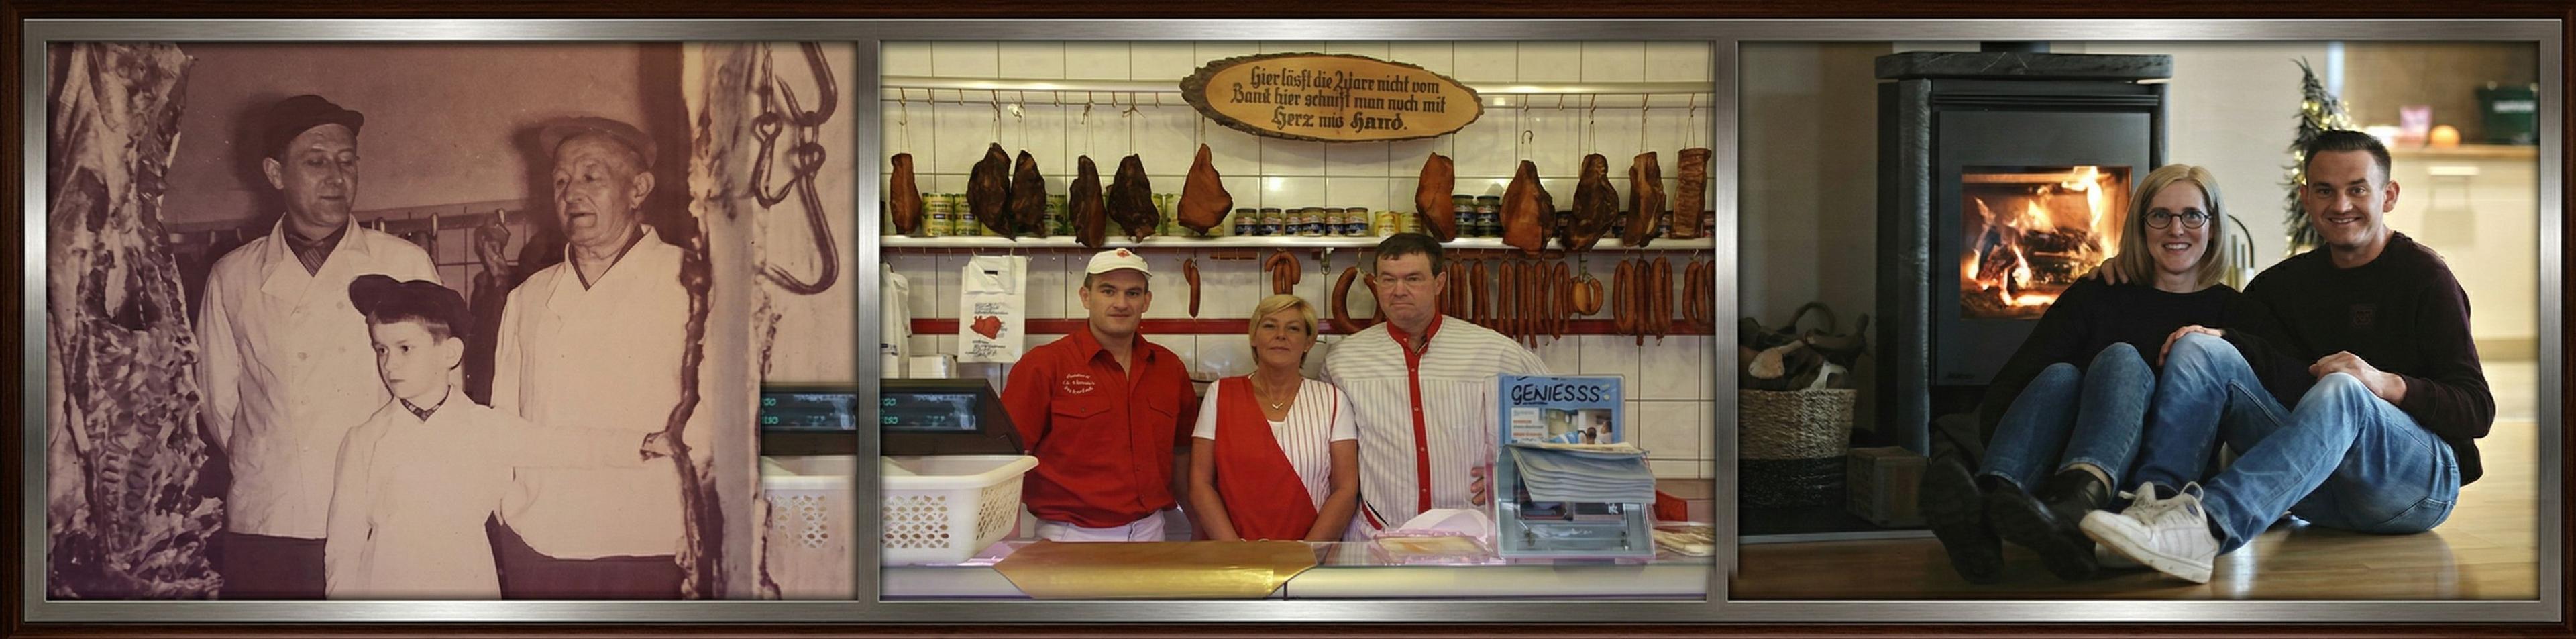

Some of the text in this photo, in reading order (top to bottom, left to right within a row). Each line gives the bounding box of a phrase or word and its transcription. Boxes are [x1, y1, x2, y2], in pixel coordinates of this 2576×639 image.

[1250, 66, 1280, 89] Hier
[1313, 70, 1332, 89] die
[1377, 75, 1410, 93] nicht
[1412, 81, 1440, 94] vom
[1275, 87, 1301, 105] hier
[1422, 95, 1446, 113] mit
[1271, 105, 1315, 130] Herz
